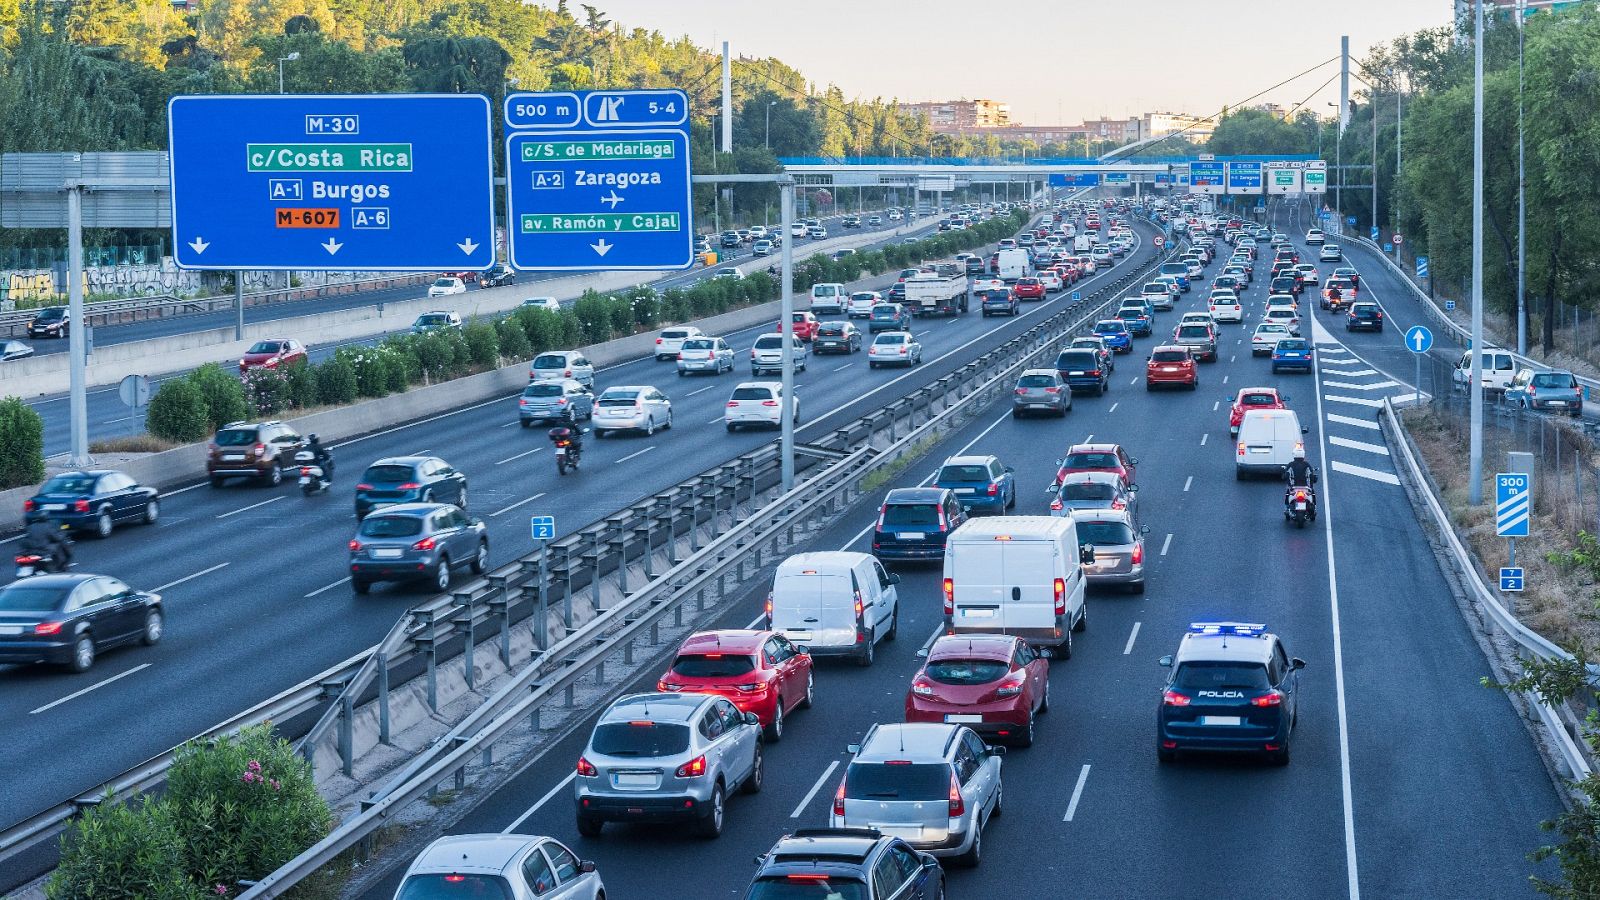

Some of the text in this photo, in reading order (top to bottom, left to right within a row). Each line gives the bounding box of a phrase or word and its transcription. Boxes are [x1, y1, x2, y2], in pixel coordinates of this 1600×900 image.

[516, 105, 569, 117] 500 m
[649, 102, 676, 114] 5-4
[309, 118, 356, 132] M-30
[525, 143, 672, 158] c/S. de Madariaga
[252, 149, 409, 167] c/Costa Rica
[536, 170, 661, 189] A-2 Zaragoza
[273, 181, 390, 203] A-1 Burgos
[278, 211, 386, 225] M-607 A-6
[525, 215, 677, 231] av. Ramón y Cajal
[1500, 478, 1524, 487] 300
[539, 527, 547, 536] 2
[1508, 580, 1516, 588] 2
